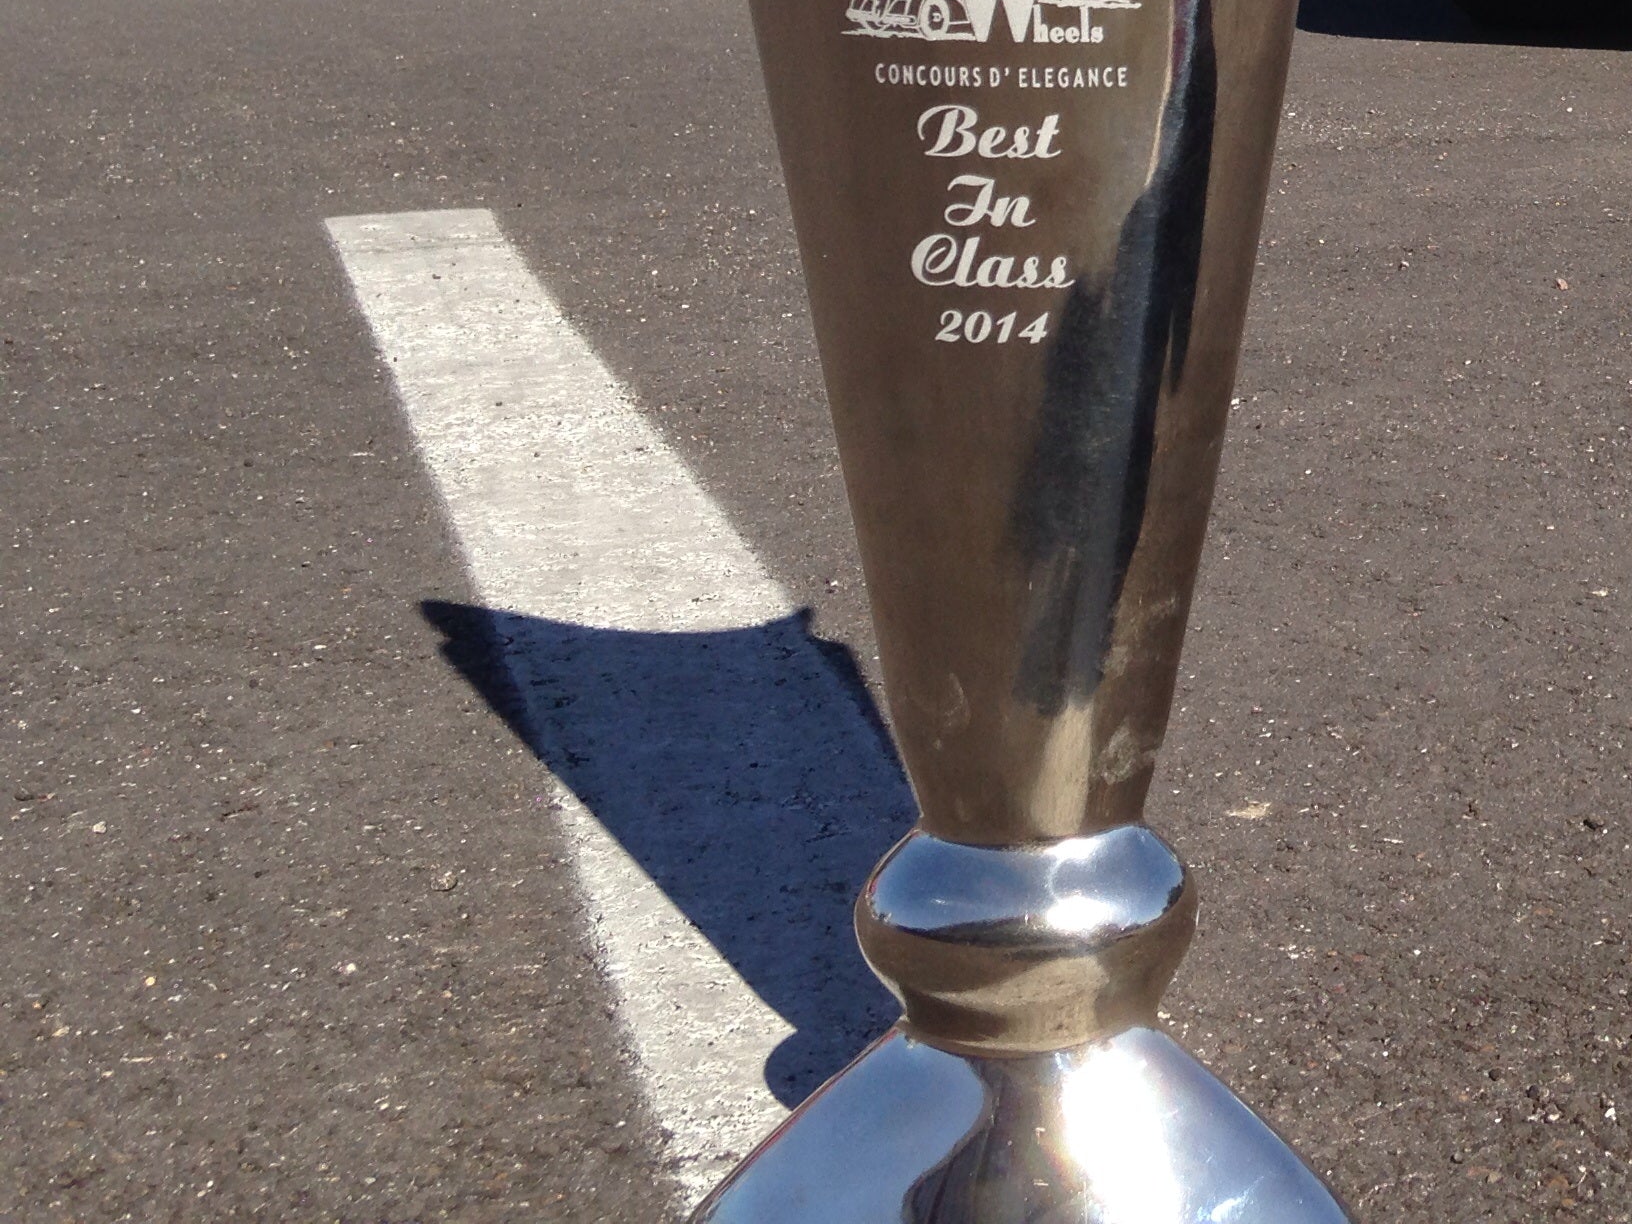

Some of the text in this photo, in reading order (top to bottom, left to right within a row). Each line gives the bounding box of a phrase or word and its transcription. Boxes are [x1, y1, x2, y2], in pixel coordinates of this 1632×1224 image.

[874, 63, 983, 87] CONCOURS
[917, 105, 1062, 159] Best
[944, 175, 1036, 227] In
[911, 234, 1076, 288] Class
[935, 310, 1049, 344] 2014
